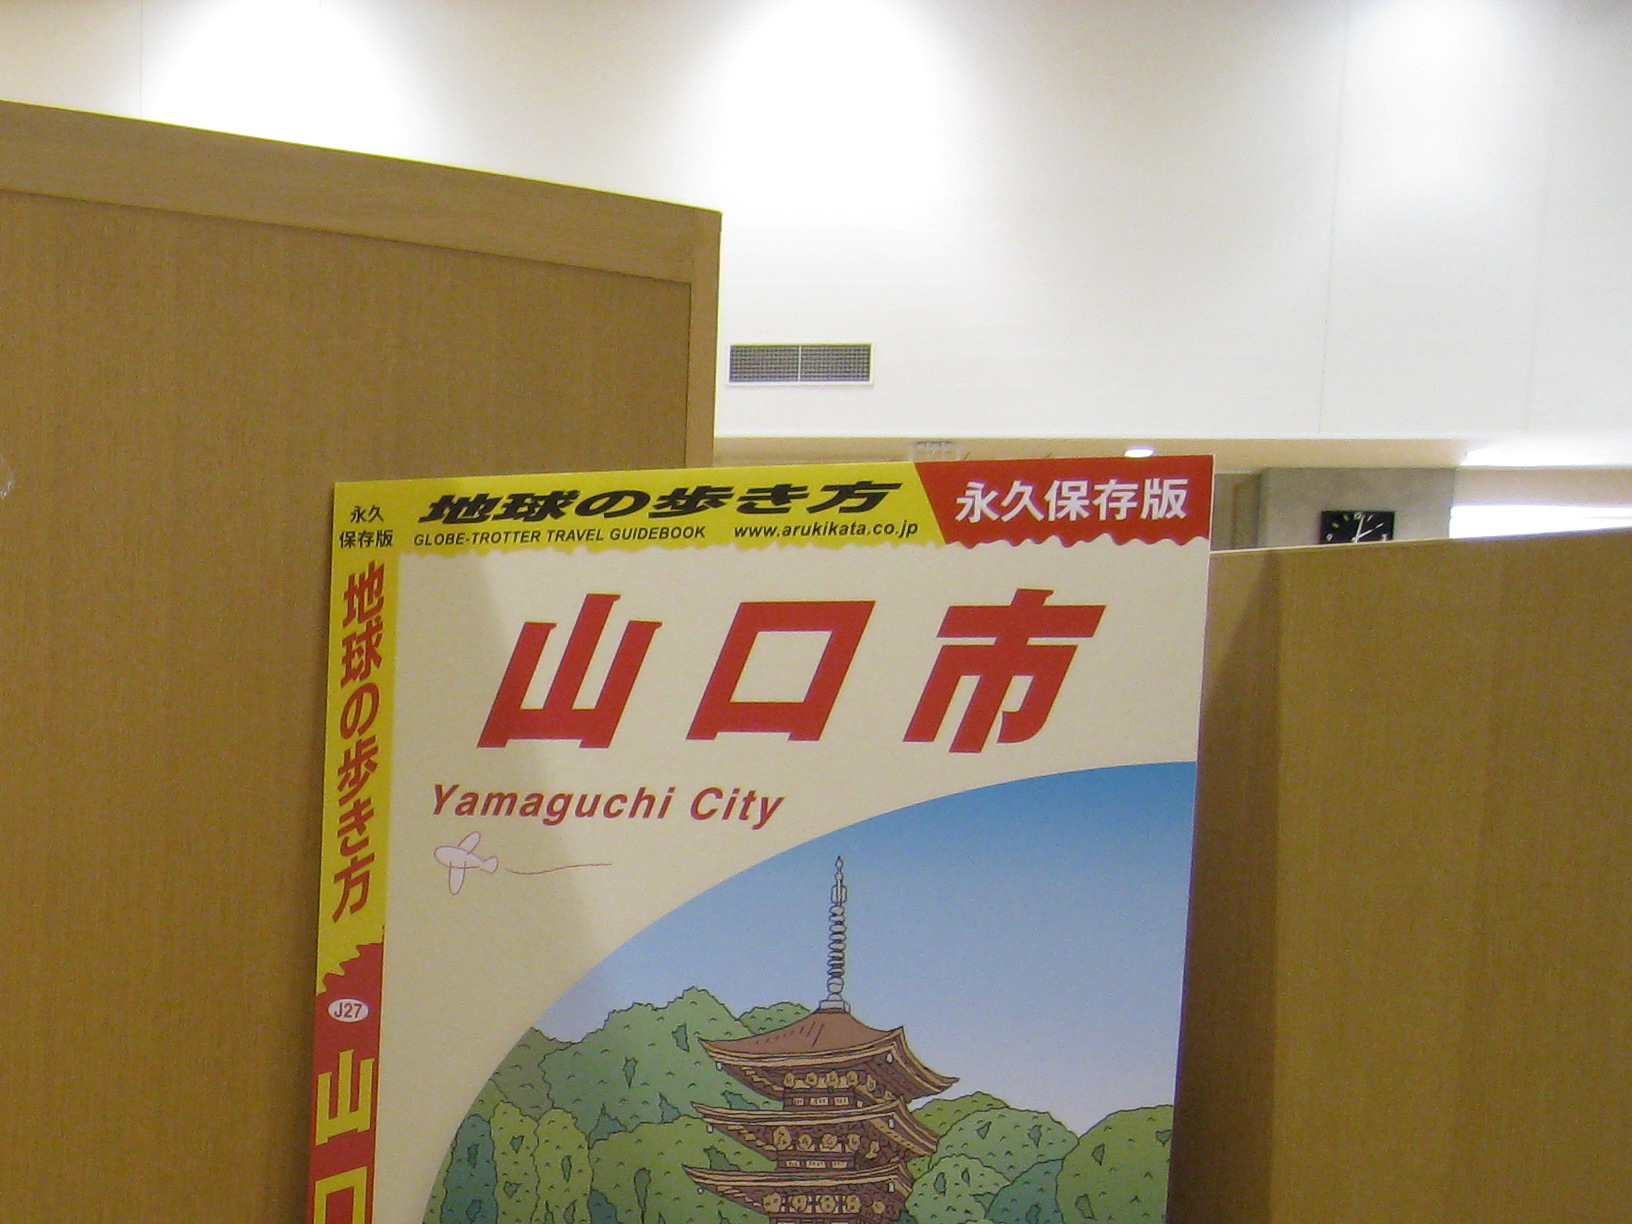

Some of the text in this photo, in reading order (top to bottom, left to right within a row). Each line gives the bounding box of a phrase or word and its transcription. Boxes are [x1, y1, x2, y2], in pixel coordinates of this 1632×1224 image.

[350, 505, 384, 523] 永久
[418, 480, 902, 525] 地球の歩き方
[955, 478, 1188, 523] 永久保存版
[339, 530, 393, 548] 保存版
[414, 520, 919, 547] GLOBE-TROTTER TRAVEL GUIDEBOOK www.arukikata.co.jp
[477, 588, 1106, 754] 山口市
[332, 560, 386, 923] 地球の歩き方
[432, 784, 785, 832] Yamaguchi City
[333, 1002, 363, 1019] J27
